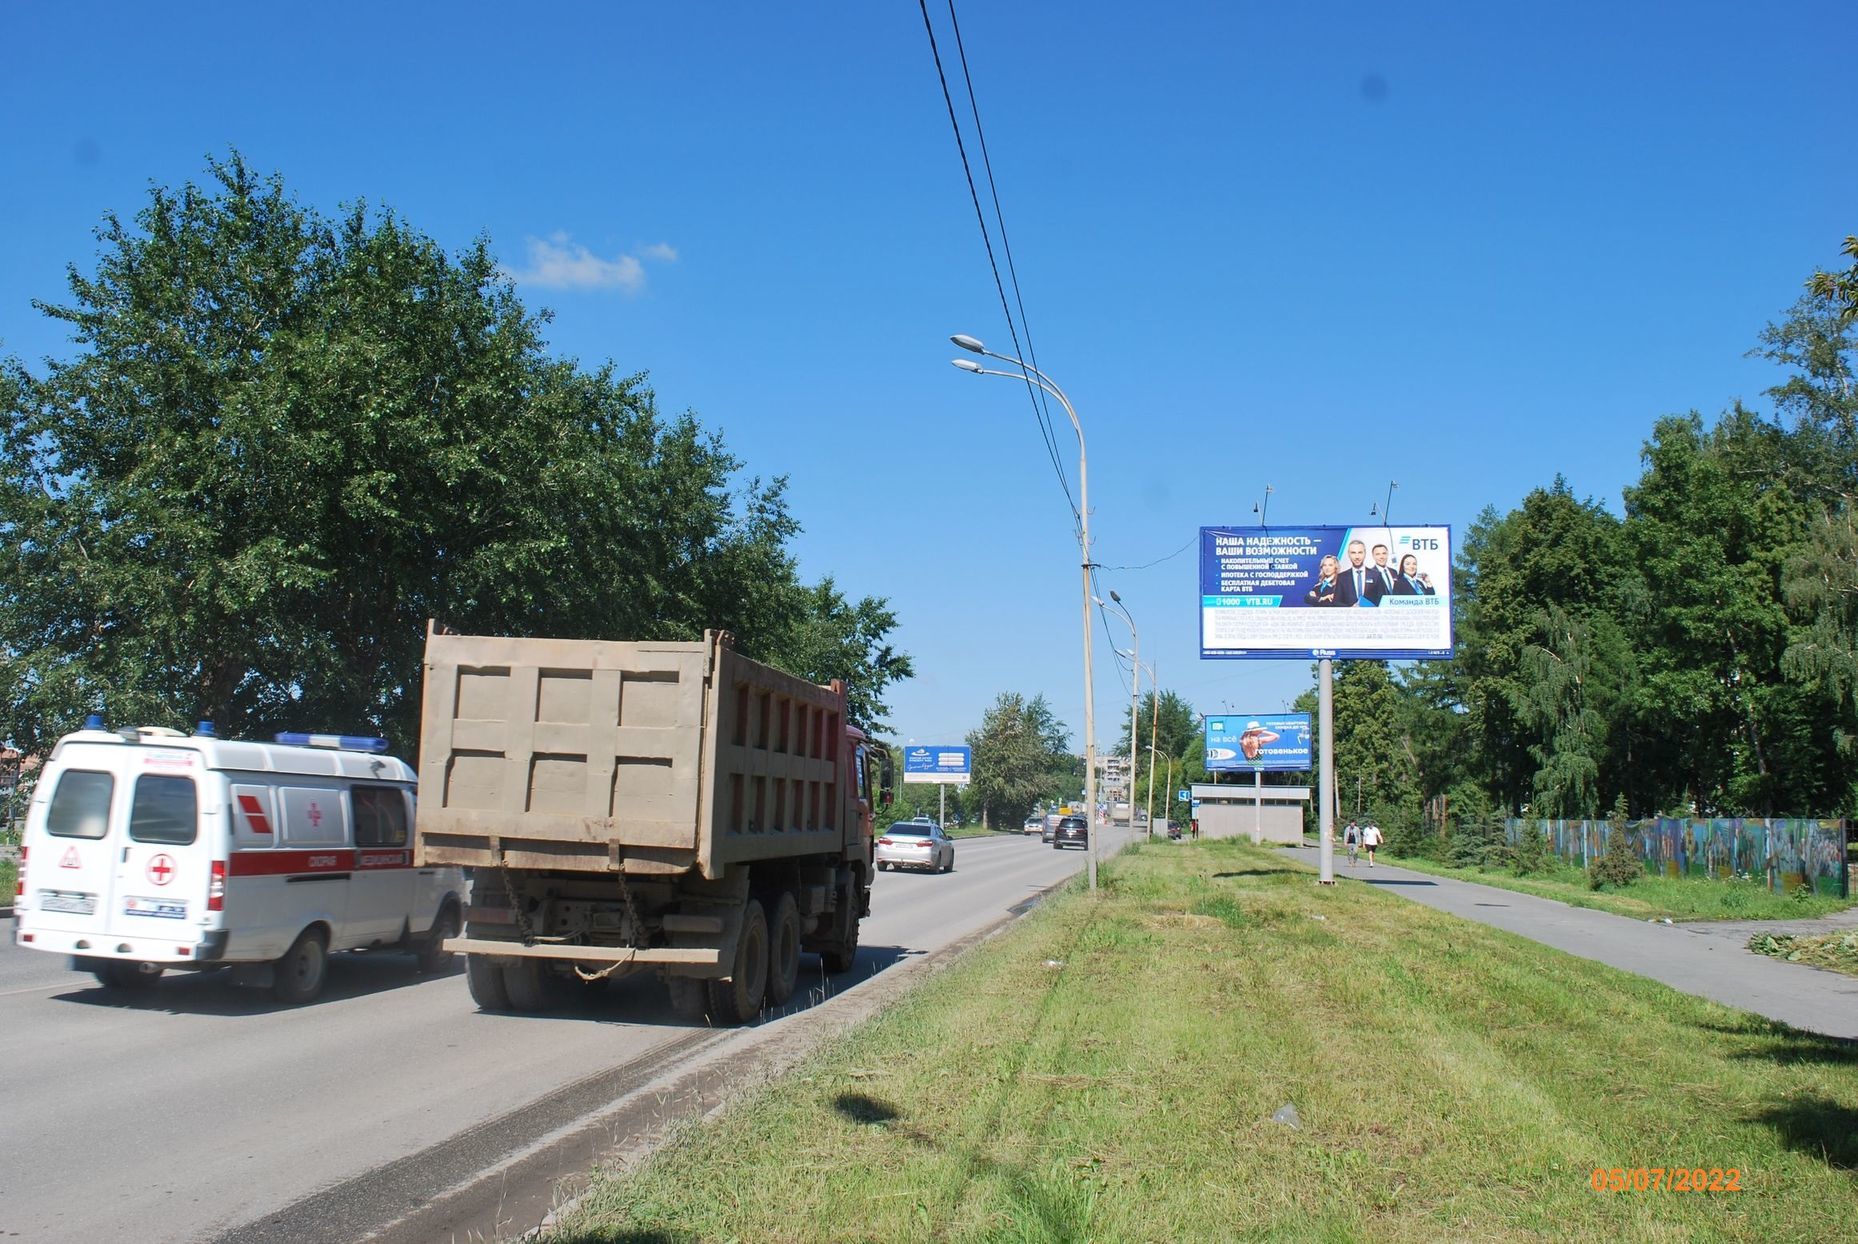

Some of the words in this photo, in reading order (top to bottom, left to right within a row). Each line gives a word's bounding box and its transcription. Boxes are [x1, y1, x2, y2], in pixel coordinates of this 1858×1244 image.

[1216, 537, 1244, 546] НАША
[1246, 536, 1311, 547] НАДЕЖНОСТЬ
[1412, 538, 1439, 551] ВТБ
[1215, 547, 1243, 556] ВАШИ
[1246, 546, 1317, 556] ВОЗМОЖНОСТИ
[1255, 571, 1309, 579] ГОСПОДДЕРЖКОЙ
[1222, 598, 1240, 606] 1000
[1246, 598, 1274, 606] VTB.RU
[1389, 598, 1424, 606] Команда
[1425, 597, 1440, 605] ВТБ
[1222, 735, 1237, 743] всё
